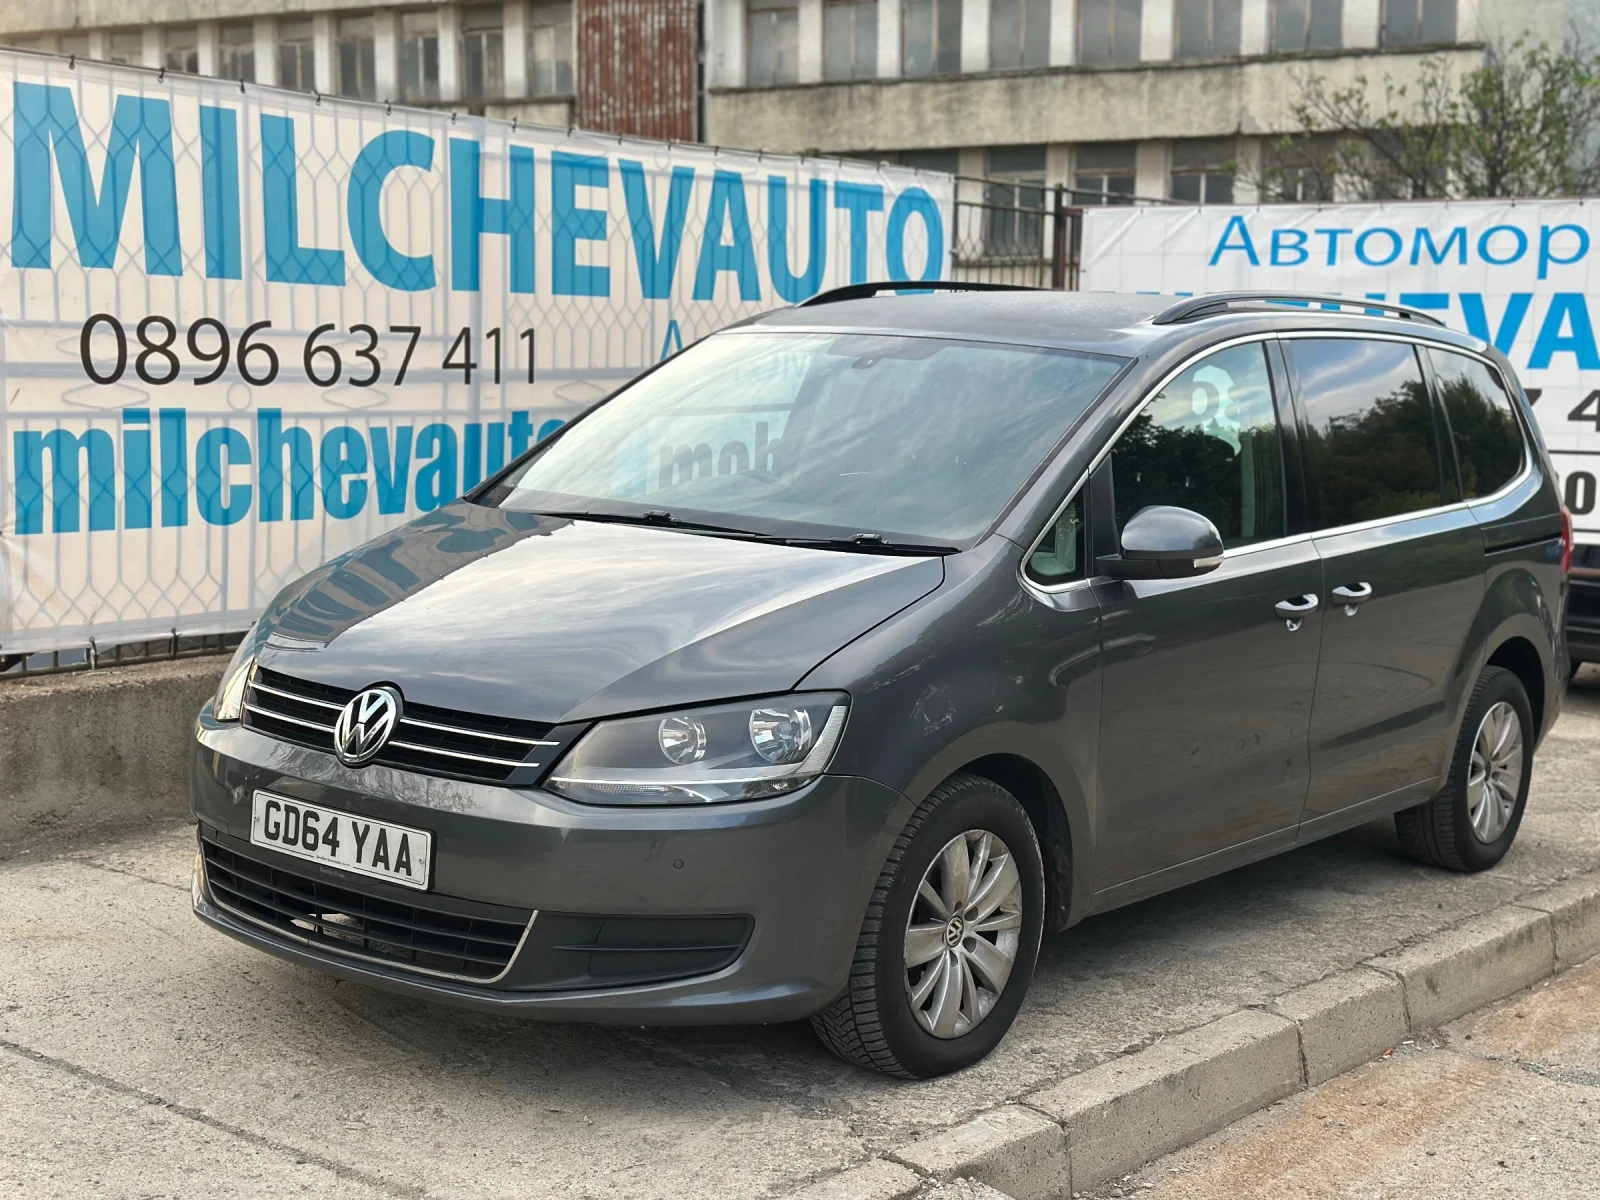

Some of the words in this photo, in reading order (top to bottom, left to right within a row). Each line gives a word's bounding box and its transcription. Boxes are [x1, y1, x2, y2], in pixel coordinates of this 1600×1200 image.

[11, 81, 944, 306] MILCHEVAUTO
[80, 313, 280, 386] 0896
[303, 323, 422, 387] 637
[442, 326, 536, 385] 411
[263, 800, 340, 857] GD64
[351, 820, 413, 877] YAA
